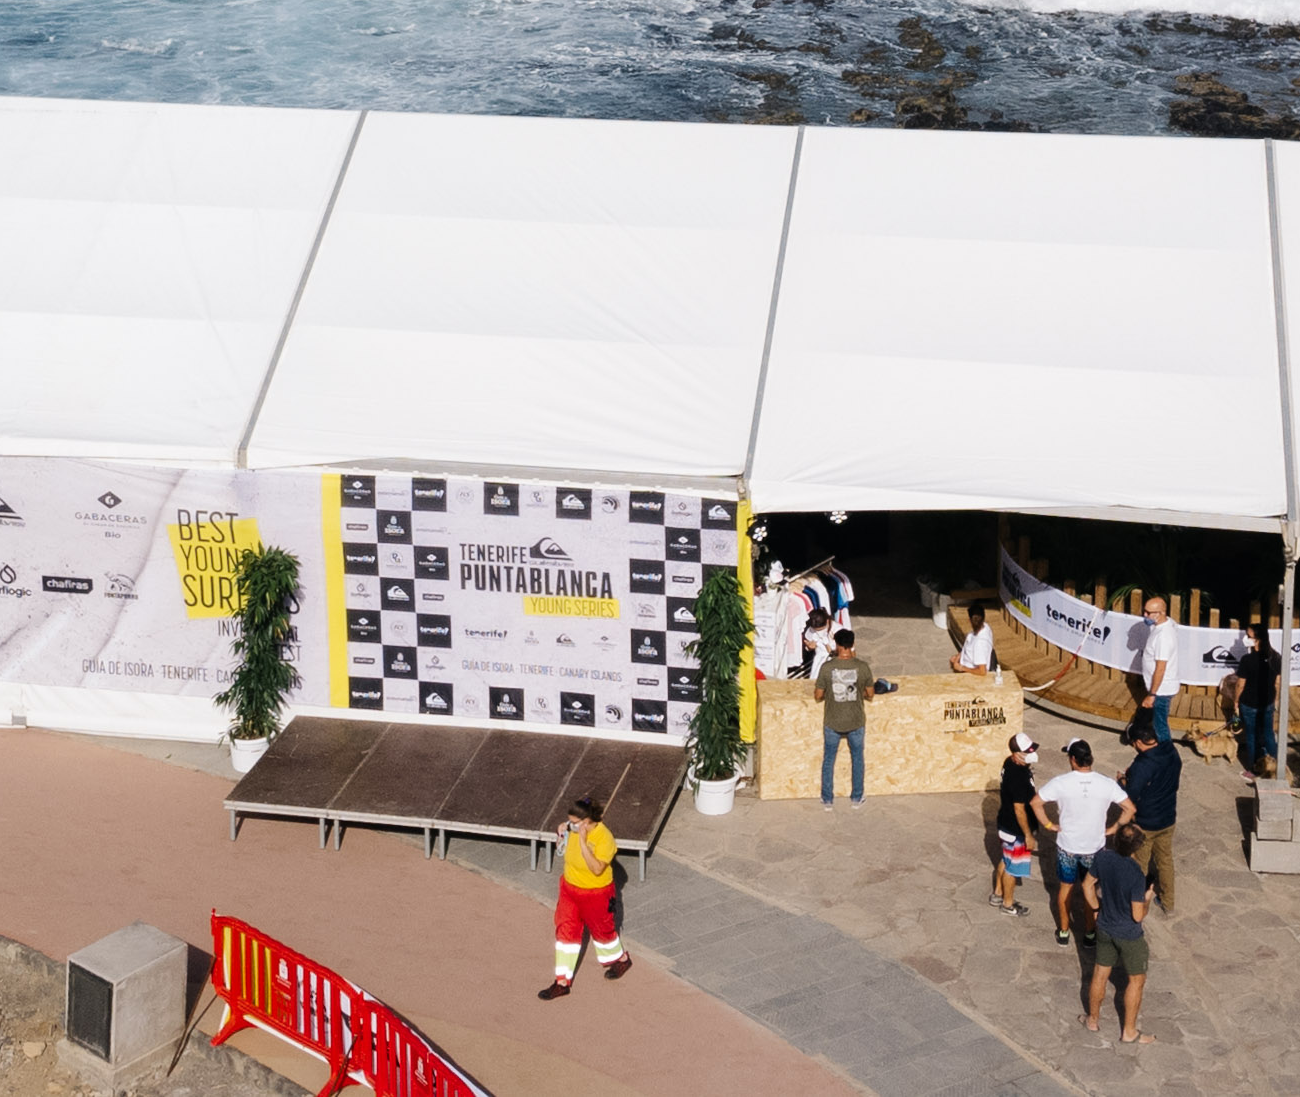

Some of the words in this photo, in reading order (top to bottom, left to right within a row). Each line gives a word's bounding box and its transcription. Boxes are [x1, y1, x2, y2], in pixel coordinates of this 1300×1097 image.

[74, 511, 147, 524] GABACERAS
[178, 509, 239, 544] BEST
[104, 531, 121, 539] Bio
[459, 543, 527, 564] TENERIFE
[460, 563, 613, 600] PUNTABLANCA
[530, 597, 571, 614] YOUNG
[574, 600, 615, 618] SERIES
[108, 661, 121, 676] DE
[124, 662, 154, 678] ISORA
[161, 665, 208, 682] TENERIFE
[481, 661, 490, 671] DE
[492, 662, 514, 673] ISORA
[520, 664, 553, 676] TENERIFE
[559, 667, 589, 679] CANARY
[591, 669, 622, 682] ISLANDS
[944, 707, 1004, 720] PUNTABLANCA
